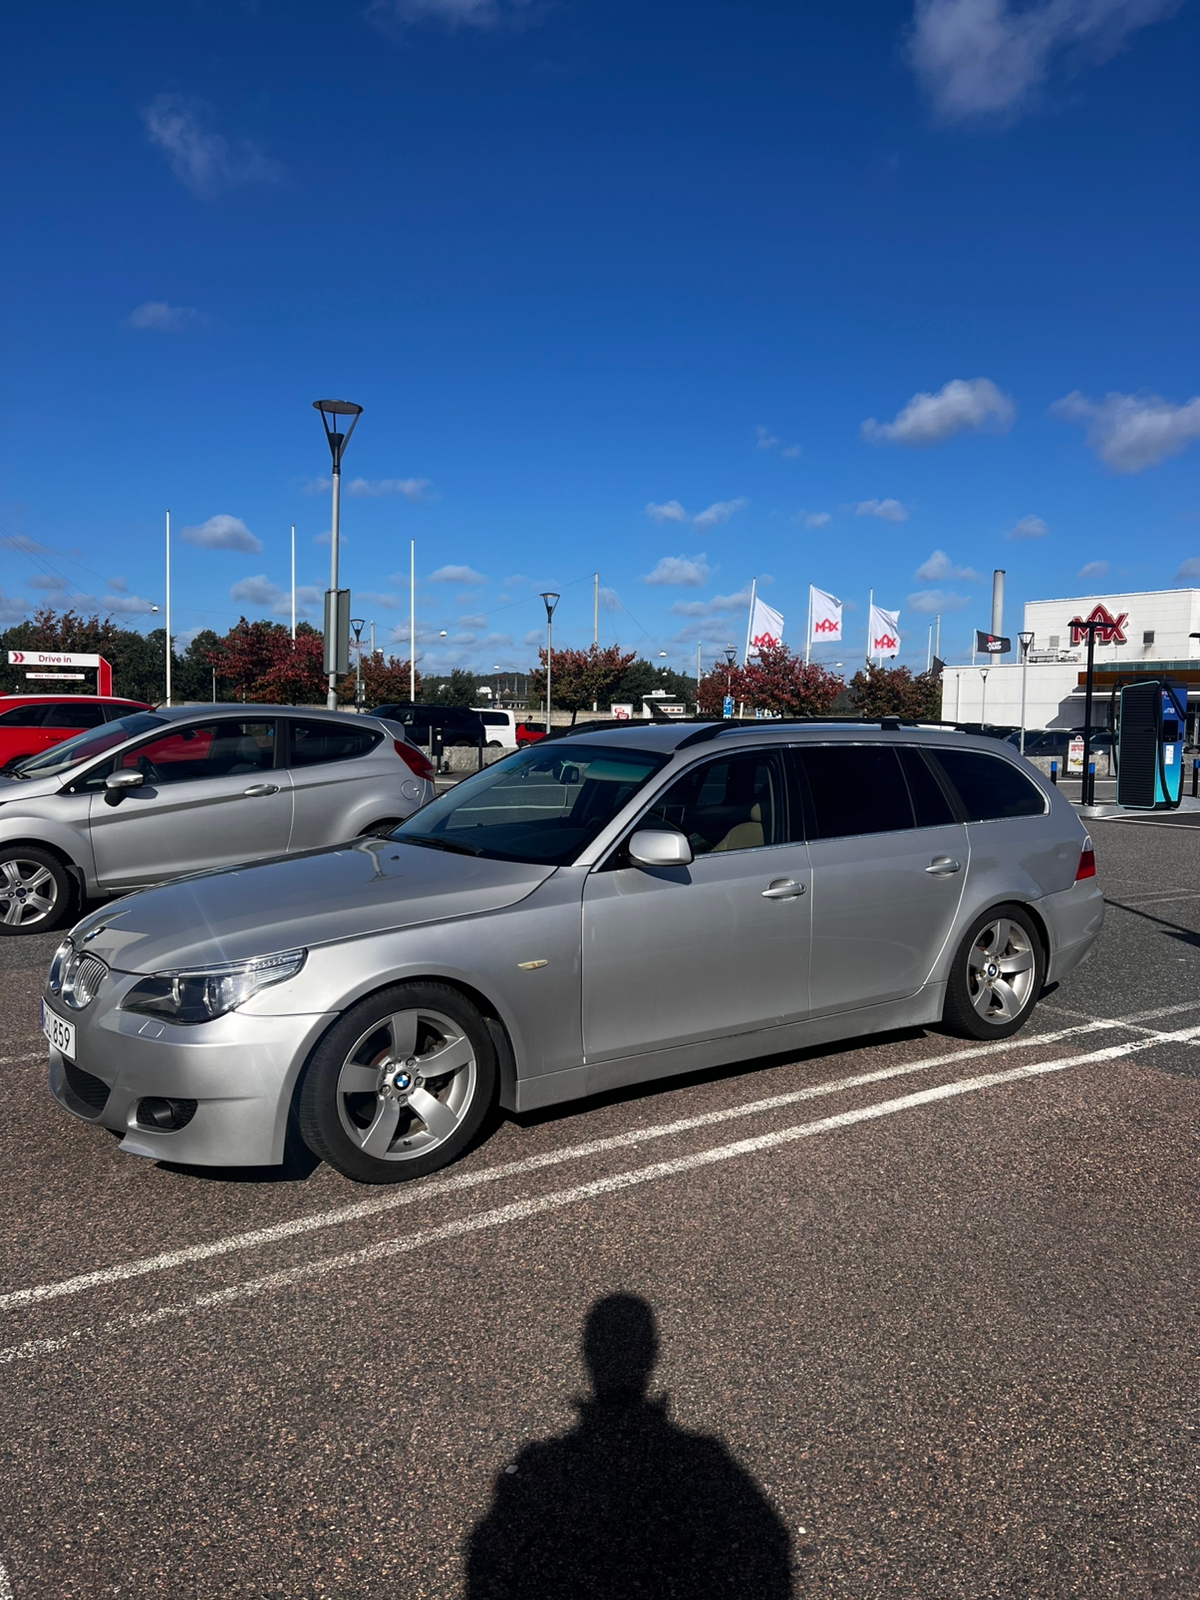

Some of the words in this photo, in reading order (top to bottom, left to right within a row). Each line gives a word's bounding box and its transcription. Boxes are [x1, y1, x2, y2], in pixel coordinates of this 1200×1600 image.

[815, 618, 840, 633] MAX
[1072, 603, 1129, 642] MAX
[754, 632, 778, 648] MAX
[874, 634, 897, 649] MAX
[38, 654, 62, 663] Drive
[63, 655, 72, 664] in
[53, 1019, 71, 1051] 859
